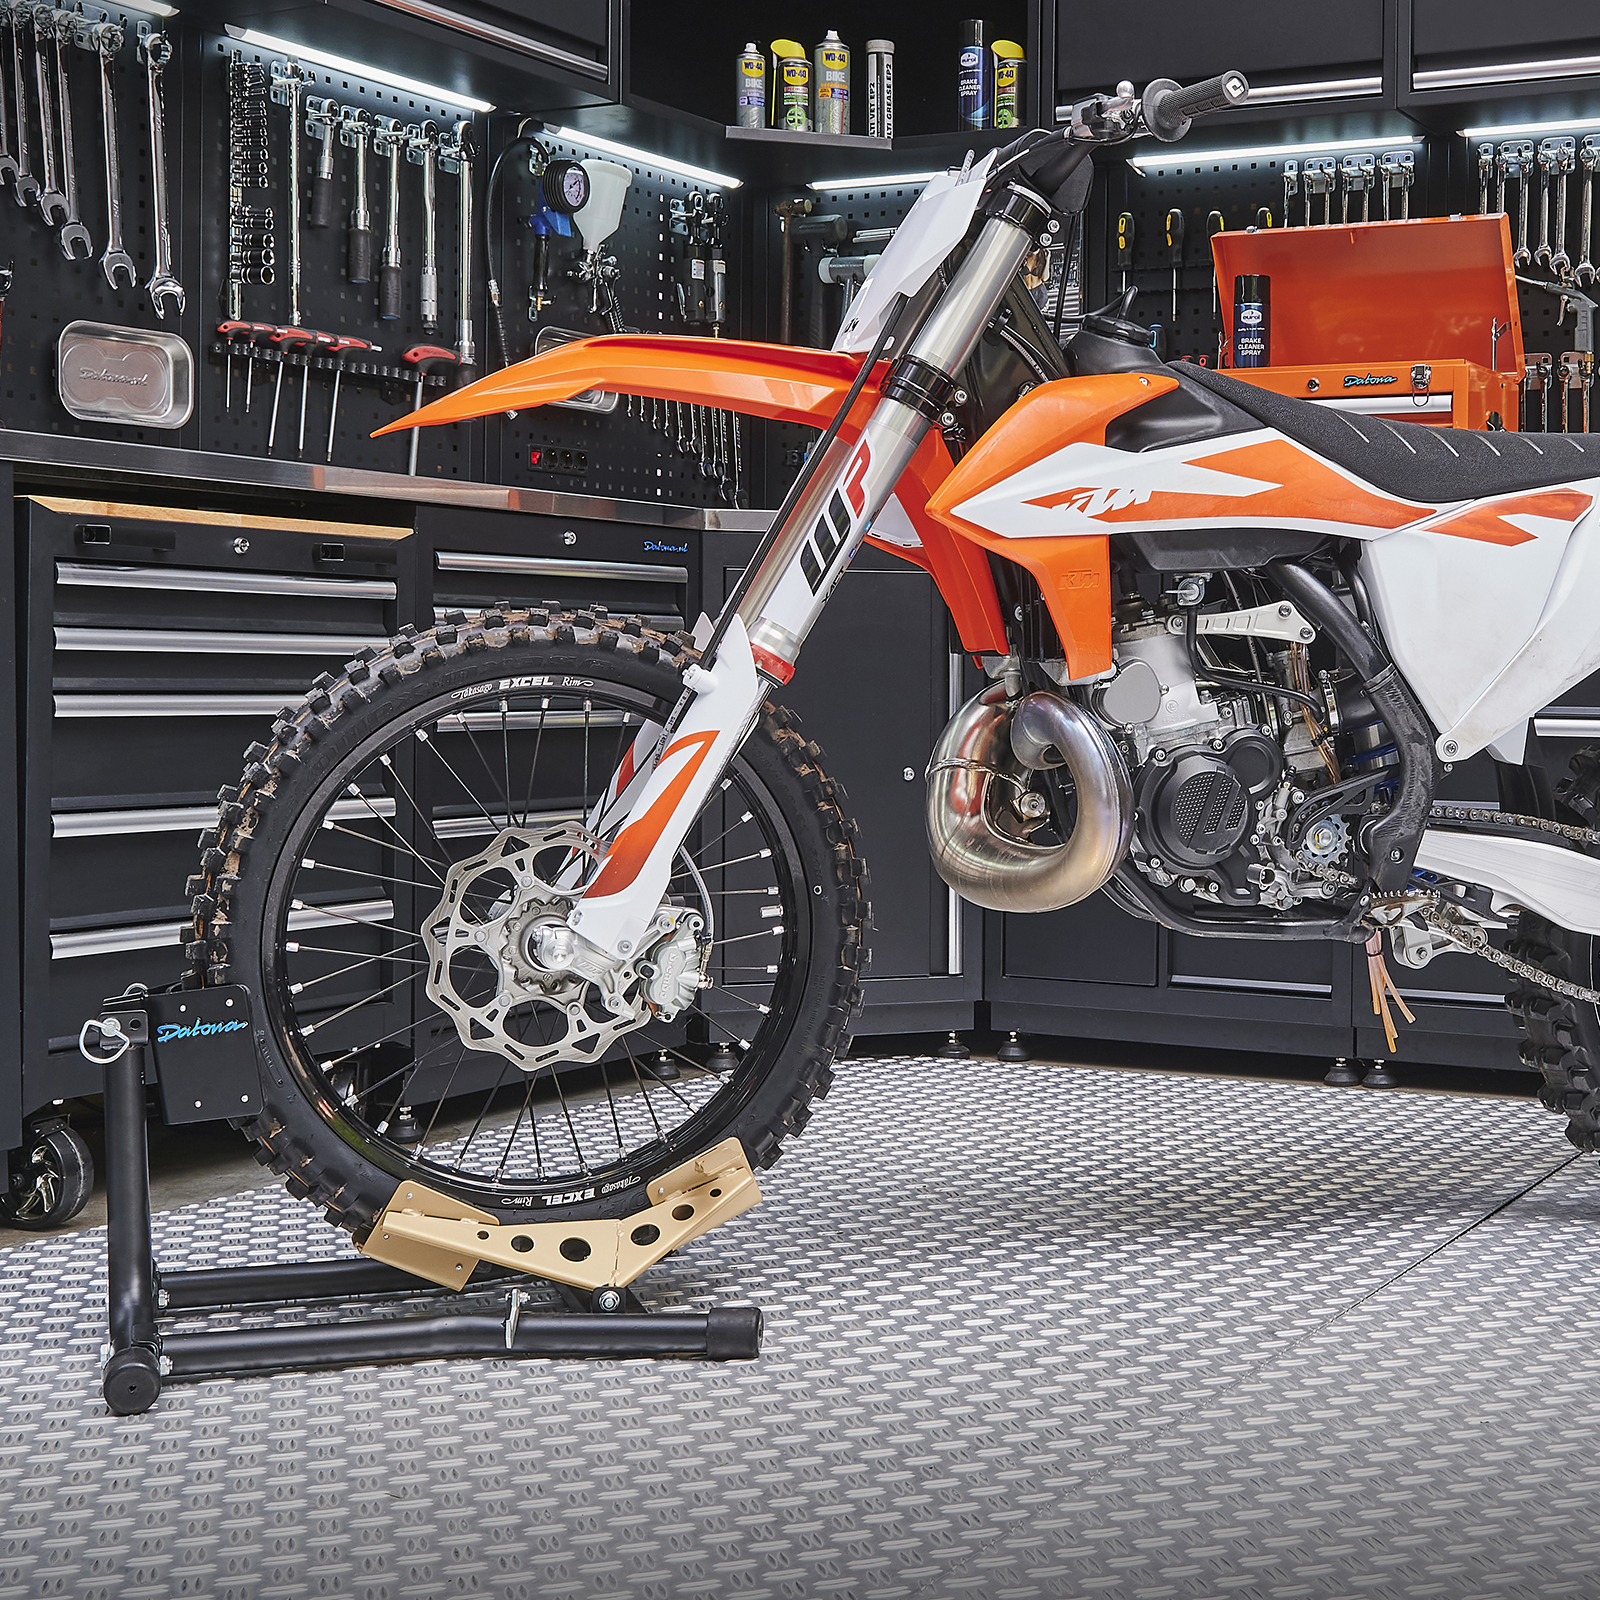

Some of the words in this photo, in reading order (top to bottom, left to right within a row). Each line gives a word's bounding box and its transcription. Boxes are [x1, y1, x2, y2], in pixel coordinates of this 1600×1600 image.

[825, 52, 846, 62] WD-40
[744, 61, 763, 71] WD-40
[786, 68, 807, 78] WD-40
[825, 70, 846, 82] BIKE
[745, 78, 763, 89] BIKE
[958, 84, 982, 92] CLEANER
[960, 78, 978, 86] BRAKE
[1343, 373, 1398, 388] Datona
[643, 540, 689, 553] Datona.nl
[1058, 569, 1100, 590] KTM
[450, 682, 493, 700] Takasago
[498, 676, 554, 690] EXCEL
[561, 676, 594, 687] Rim
[659, 952, 678, 1000] brembo
[156, 1017, 249, 1043] Datona
[500, 1196, 534, 1207] Rim
[541, 1187, 596, 1206] EXCEL
